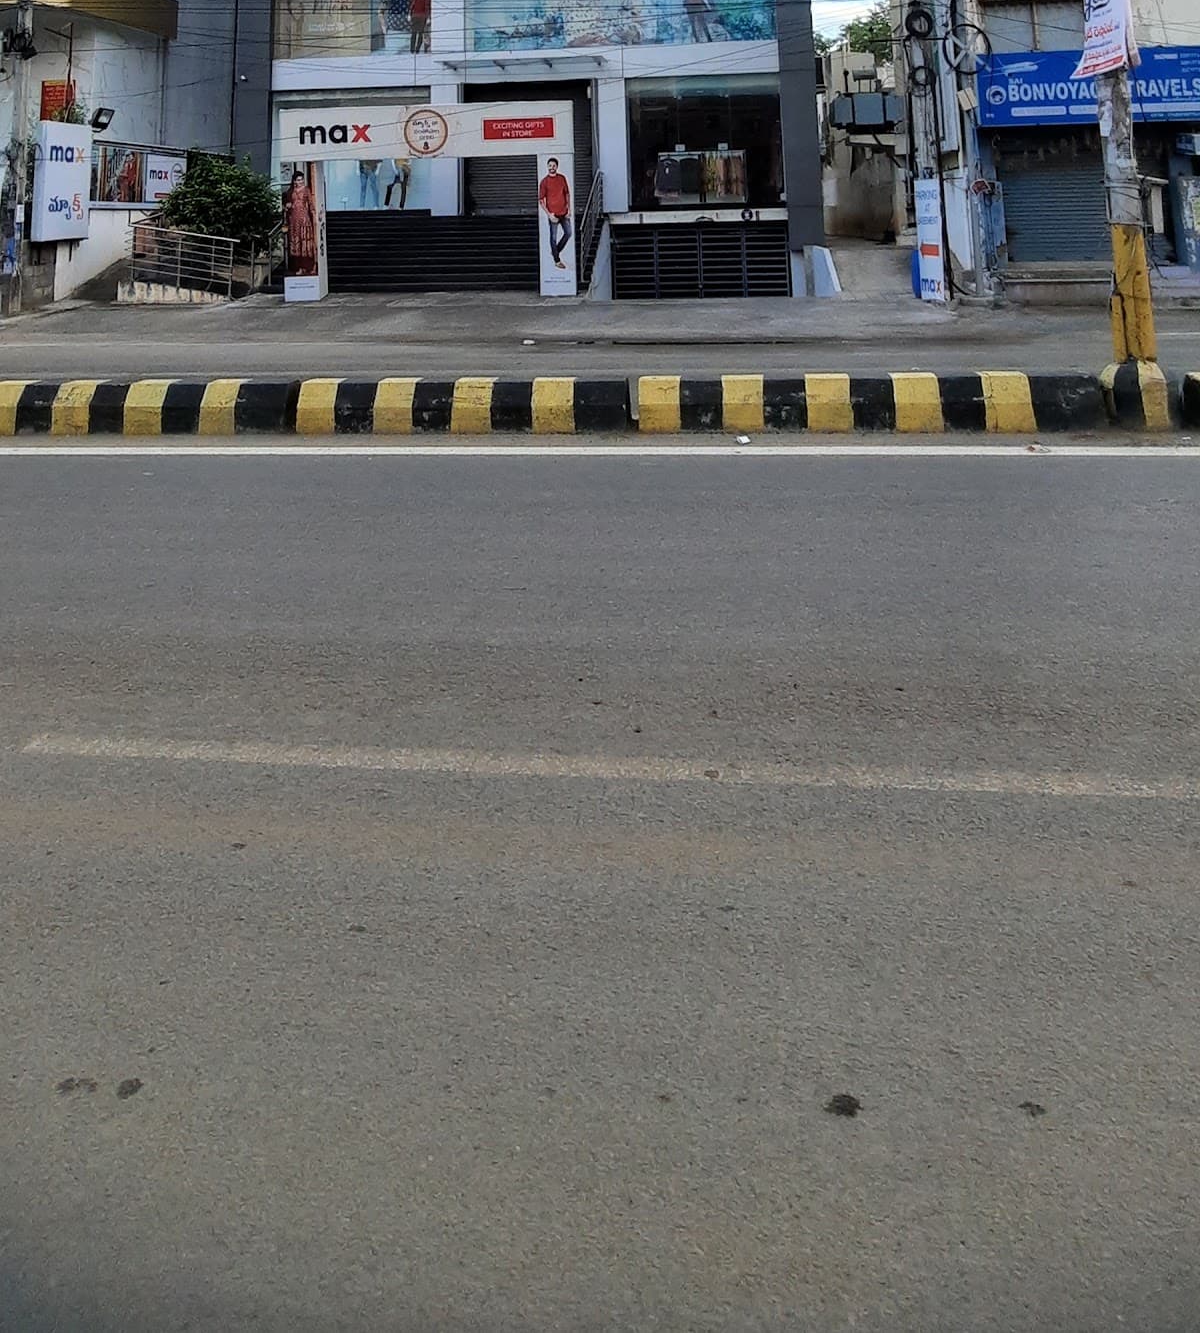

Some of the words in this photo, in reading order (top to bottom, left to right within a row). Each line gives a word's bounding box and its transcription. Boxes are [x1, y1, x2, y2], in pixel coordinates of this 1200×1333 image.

[299, 124, 371, 145] max
[50, 145, 86, 164] max
[149, 169, 169, 181] max
[921, 278, 942, 294] max
